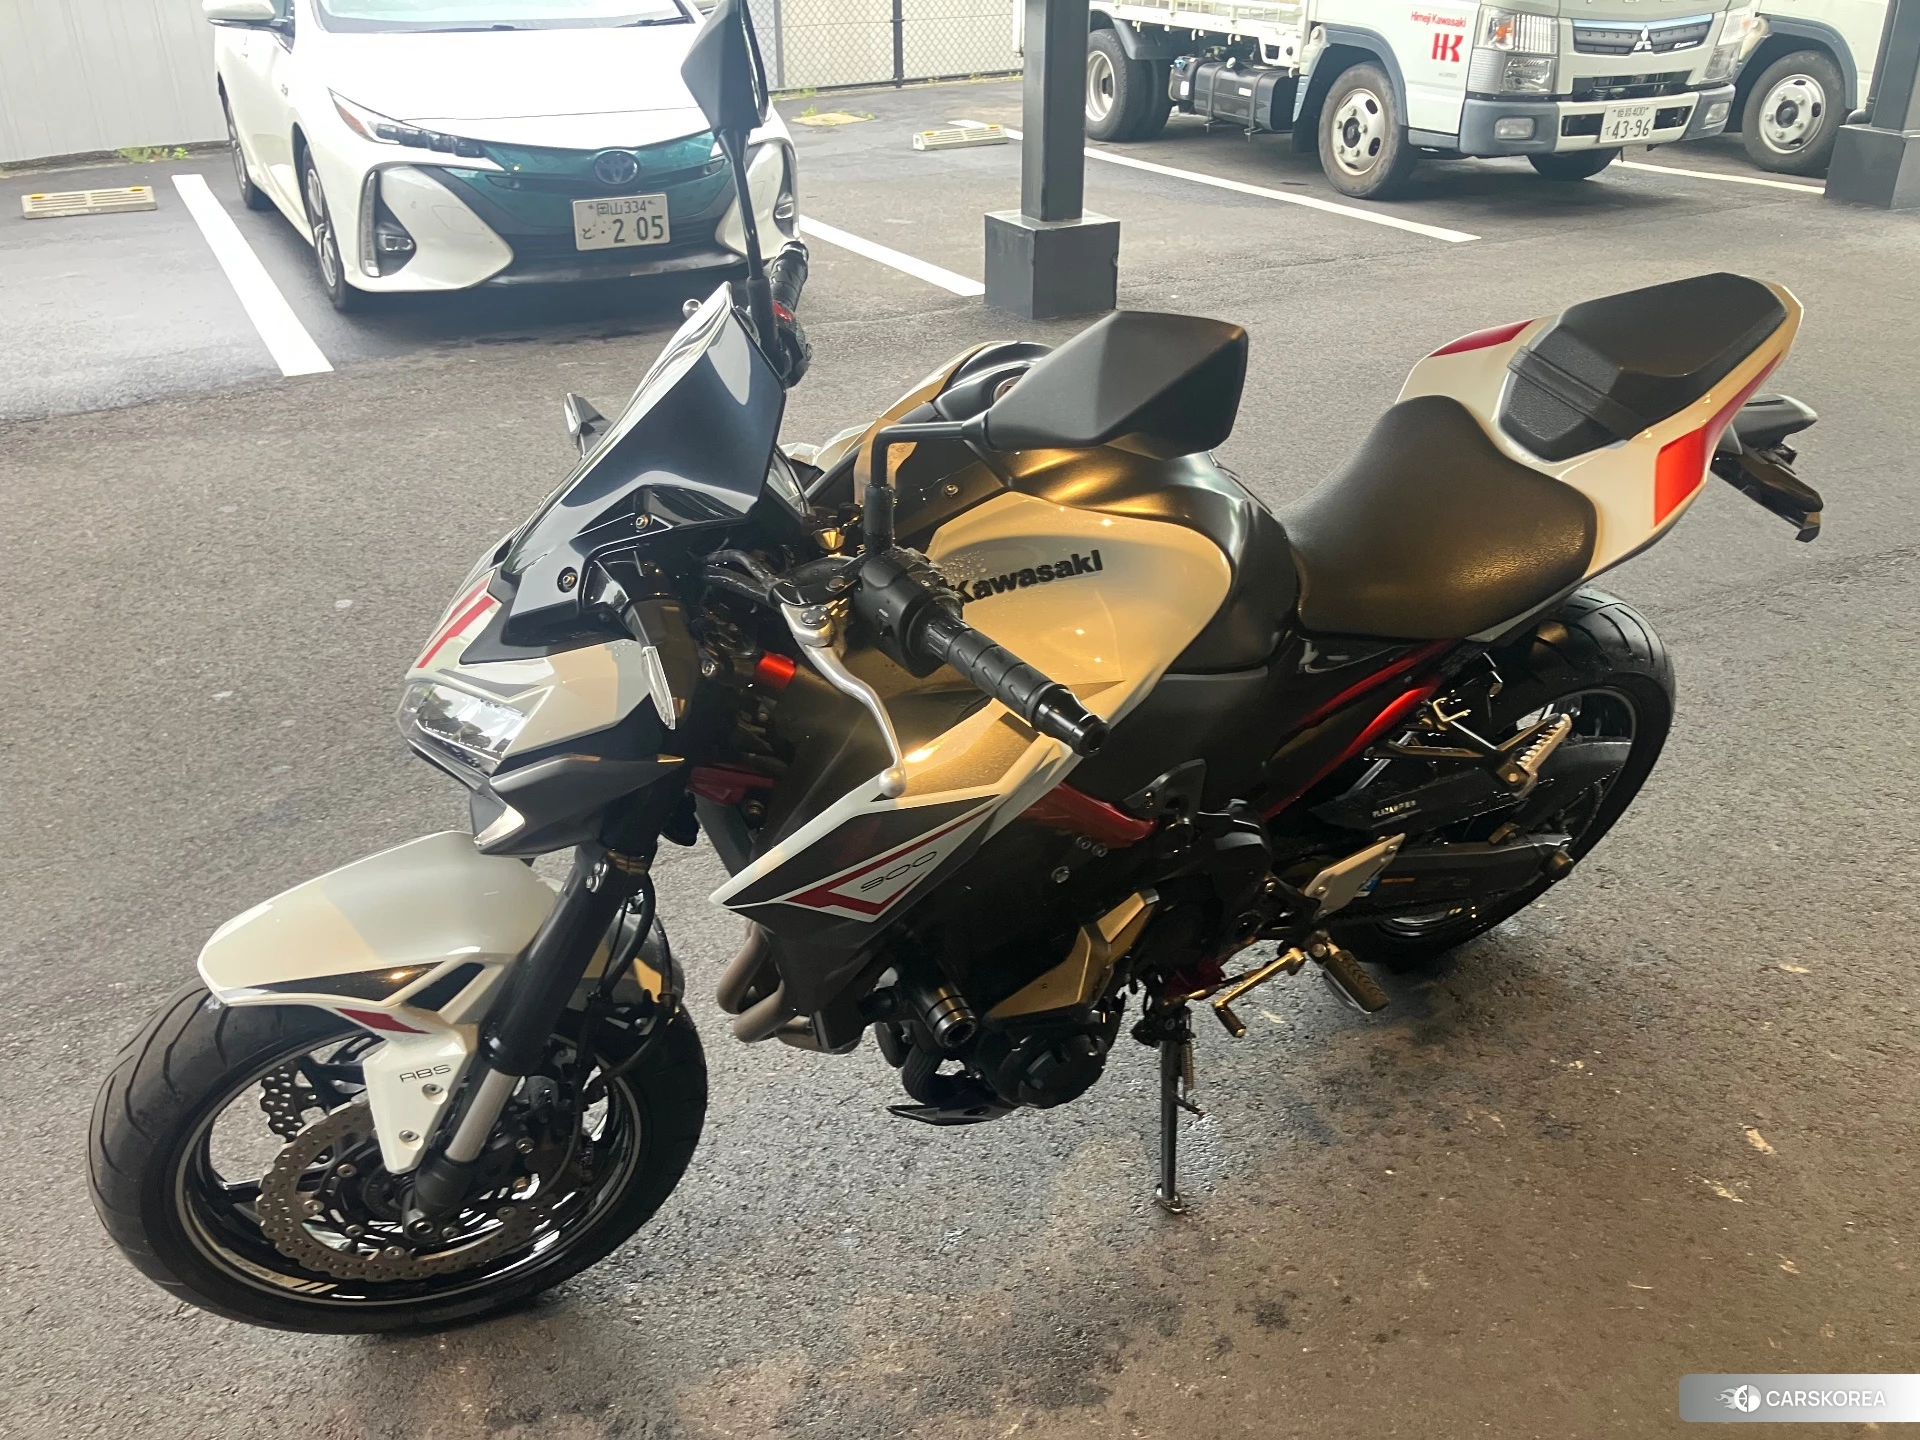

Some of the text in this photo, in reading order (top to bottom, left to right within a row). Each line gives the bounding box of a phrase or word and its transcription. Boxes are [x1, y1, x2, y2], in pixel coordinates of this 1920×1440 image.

[1432, 14, 1467, 28] Kawasaki
[1612, 119, 1651, 139] 43-96
[951, 549, 1103, 604] Kawasaki
[860, 851, 937, 893] 900
[400, 1064, 451, 1082] ABS
